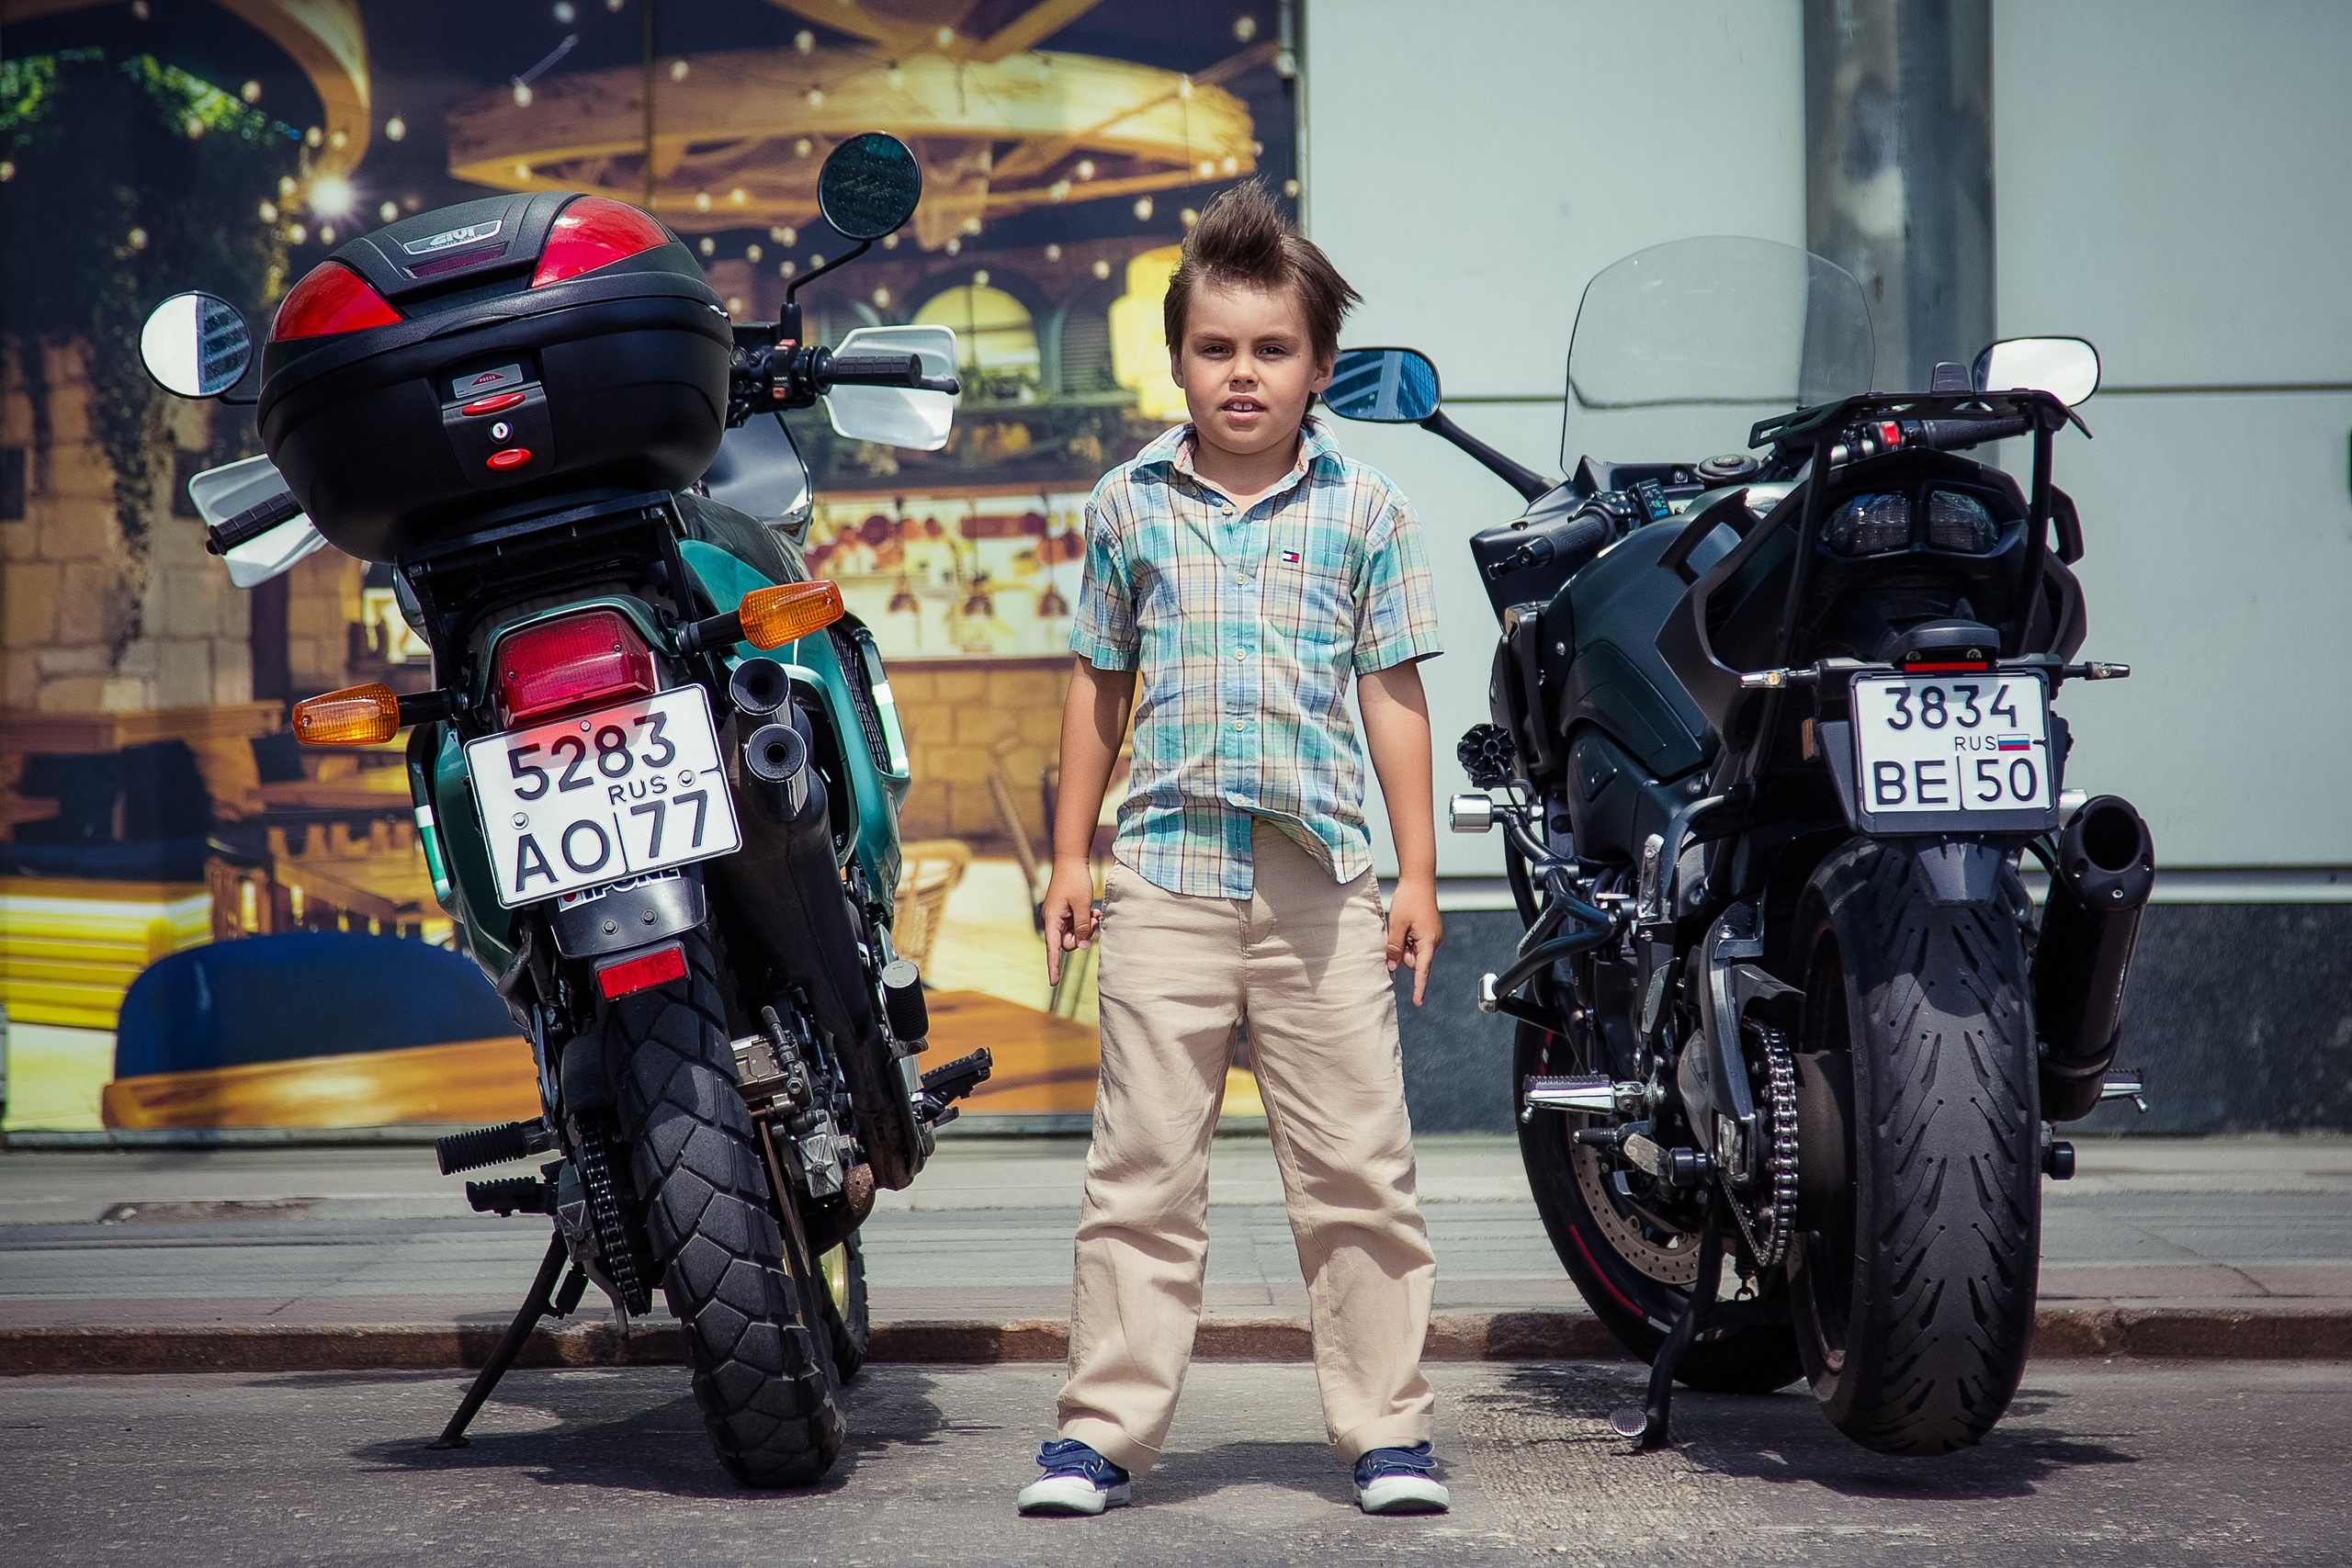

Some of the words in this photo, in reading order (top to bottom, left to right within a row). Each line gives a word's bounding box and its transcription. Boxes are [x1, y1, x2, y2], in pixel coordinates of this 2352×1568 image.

[429, 228, 476, 245] GIVI
[479, 375, 496, 383] PRESS
[1885, 684, 2018, 730] 3834
[507, 711, 676, 801] 5283
[1954, 736, 1996, 751] RUS
[608, 775, 668, 805] RUS
[1873, 760, 1949, 806] BE
[1976, 758, 2038, 802] 50
[515, 819, 611, 892] AO
[630, 789, 708, 859] 77
